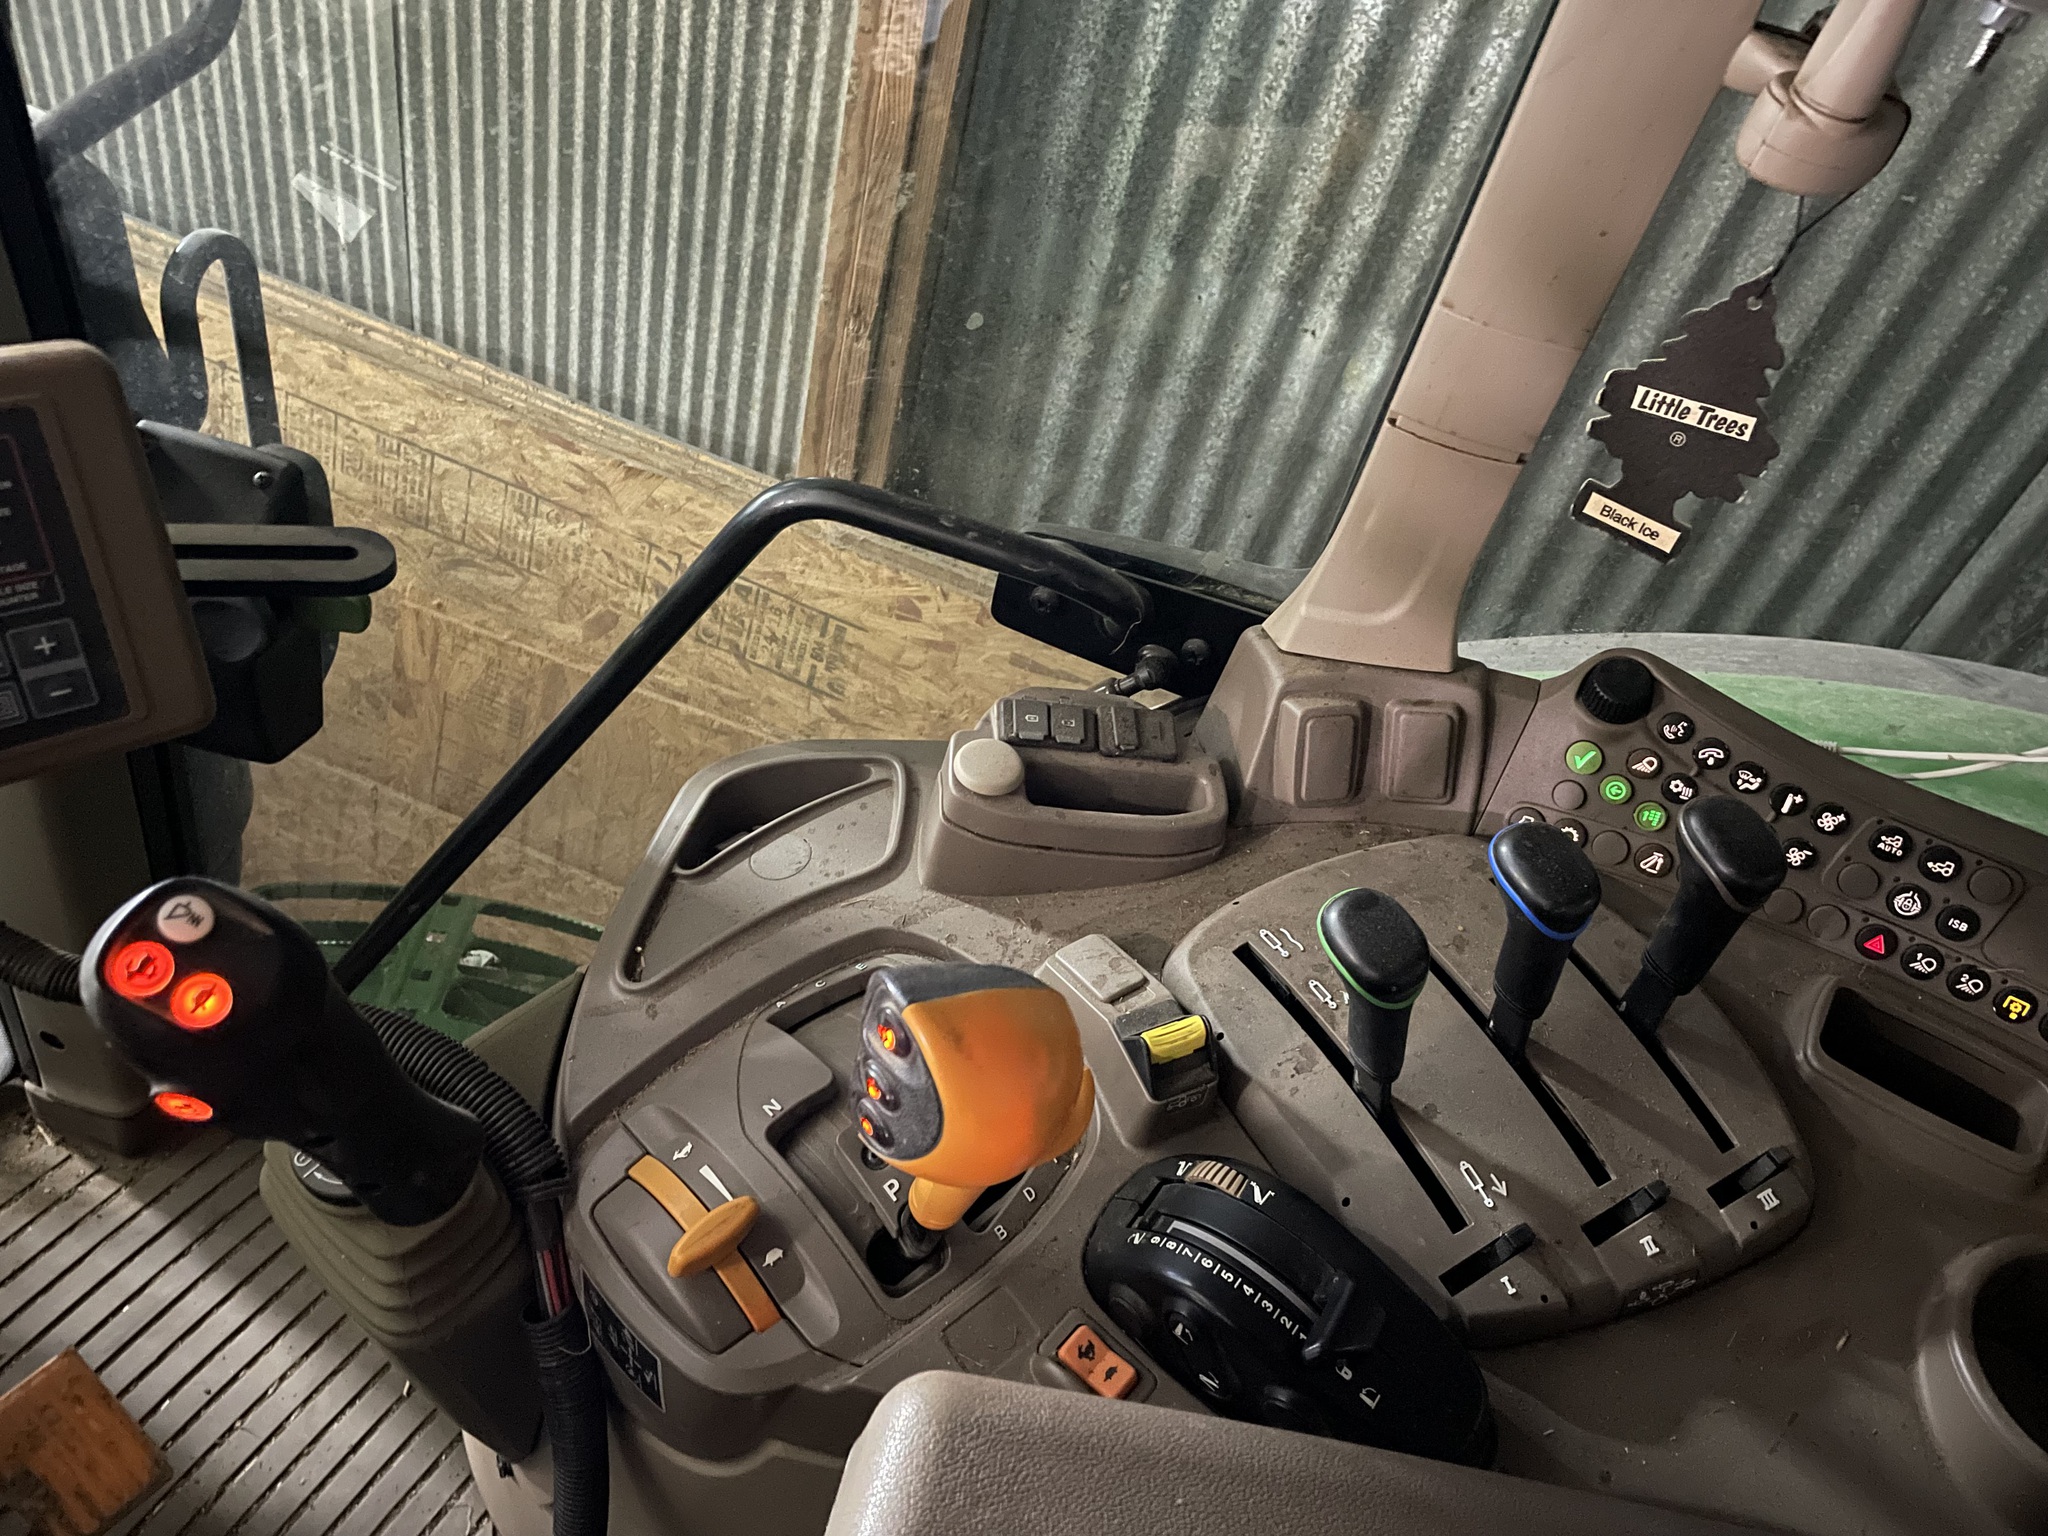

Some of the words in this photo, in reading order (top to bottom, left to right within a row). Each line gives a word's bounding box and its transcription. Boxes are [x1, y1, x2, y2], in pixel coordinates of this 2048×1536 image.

[1637, 389, 1691, 420] Little
[1697, 405, 1749, 437] Trees
[1599, 504, 1638, 531] Black
[1638, 522, 1660, 541] Ice
[1876, 842, 1903, 857] AUTO
[1947, 918, 1968, 932] ISB
[762, 1098, 782, 1117] N
[882, 1178, 900, 1202] P
[1022, 1186, 1036, 1202] D
[994, 1224, 1008, 1240] B
